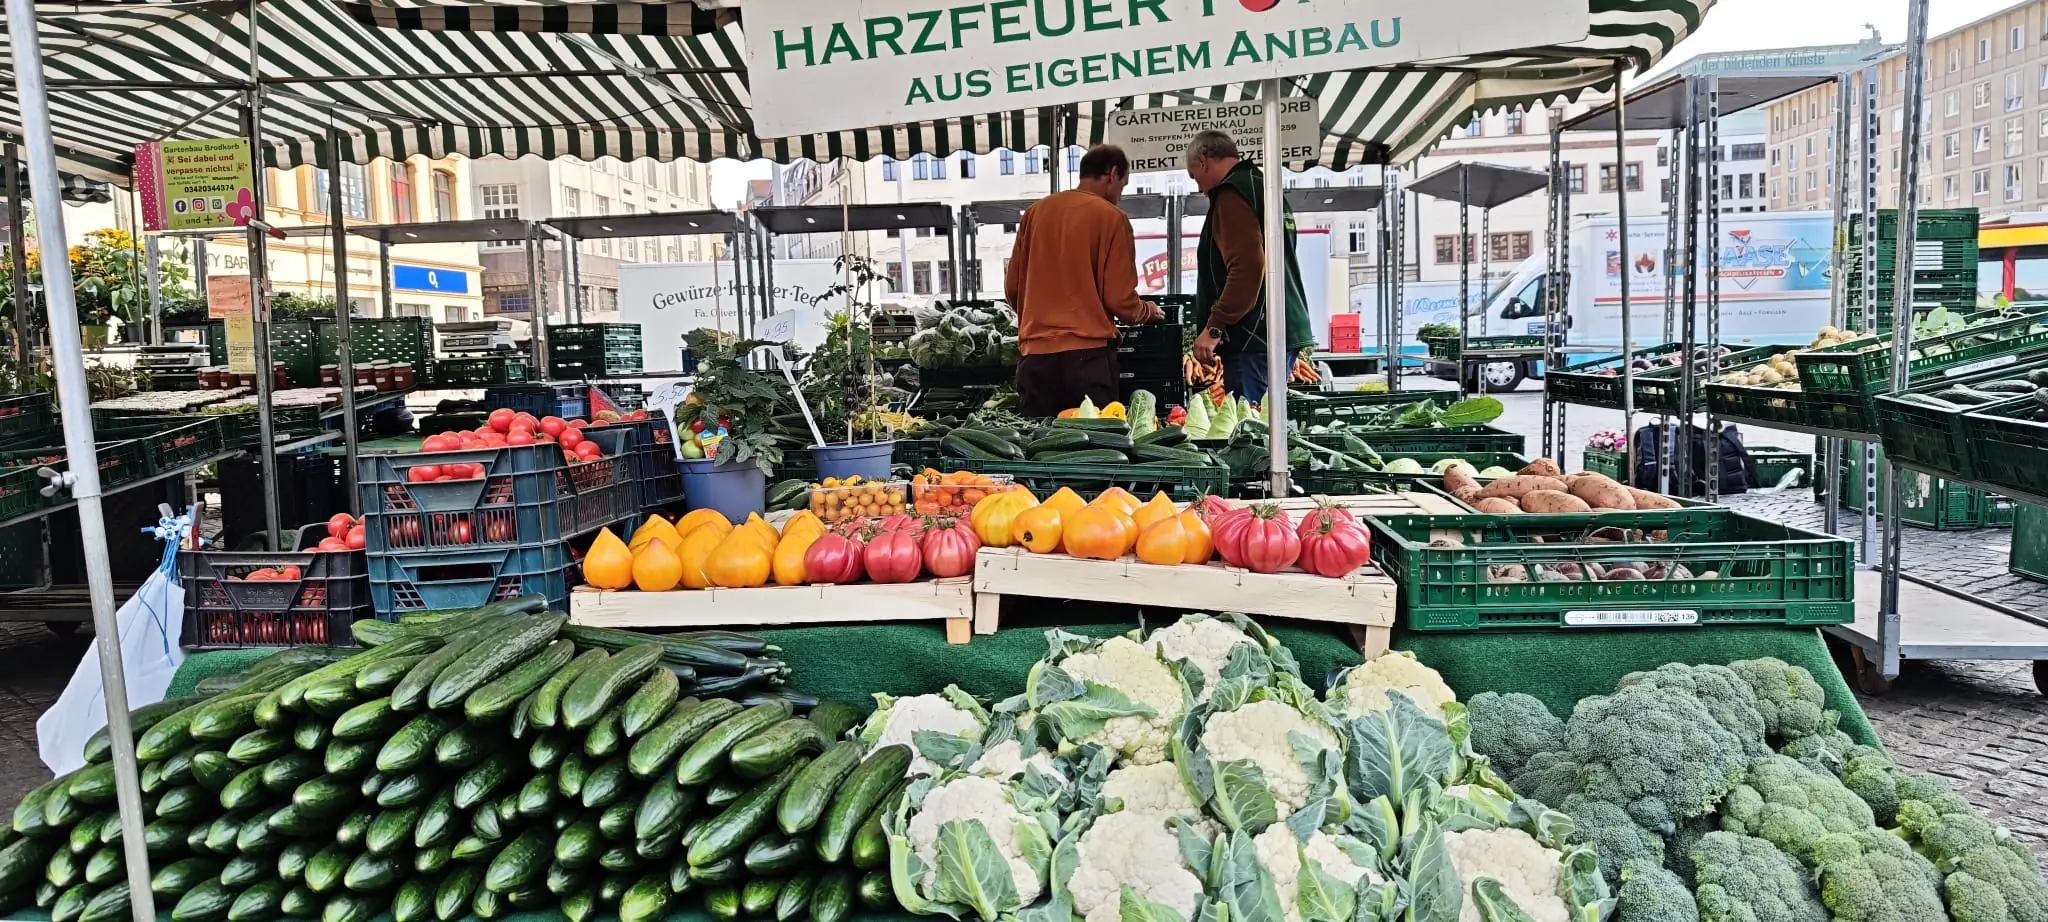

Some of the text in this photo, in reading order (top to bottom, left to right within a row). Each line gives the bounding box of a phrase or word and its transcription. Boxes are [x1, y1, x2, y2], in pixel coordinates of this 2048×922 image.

[773, 0, 1172, 69] HARZFEUER
[904, 17, 1401, 106] AUS EIGENEM ANBAU
[1701, 56, 1719, 72] der
[1724, 54, 1781, 70] bildenden
[1785, 51, 1825, 68] Künste
[1115, 100, 1312, 126] GÄRTNEREI BRODORB
[1181, 118, 1246, 132] ZWENKAU
[163, 143, 240, 154] Gartenbau Brodkorb
[177, 153, 234, 164] Sei dabei und
[1130, 155, 1179, 171] IREKT
[166, 164, 233, 176] verpasse nichts!
[185, 216, 201, 225] und
